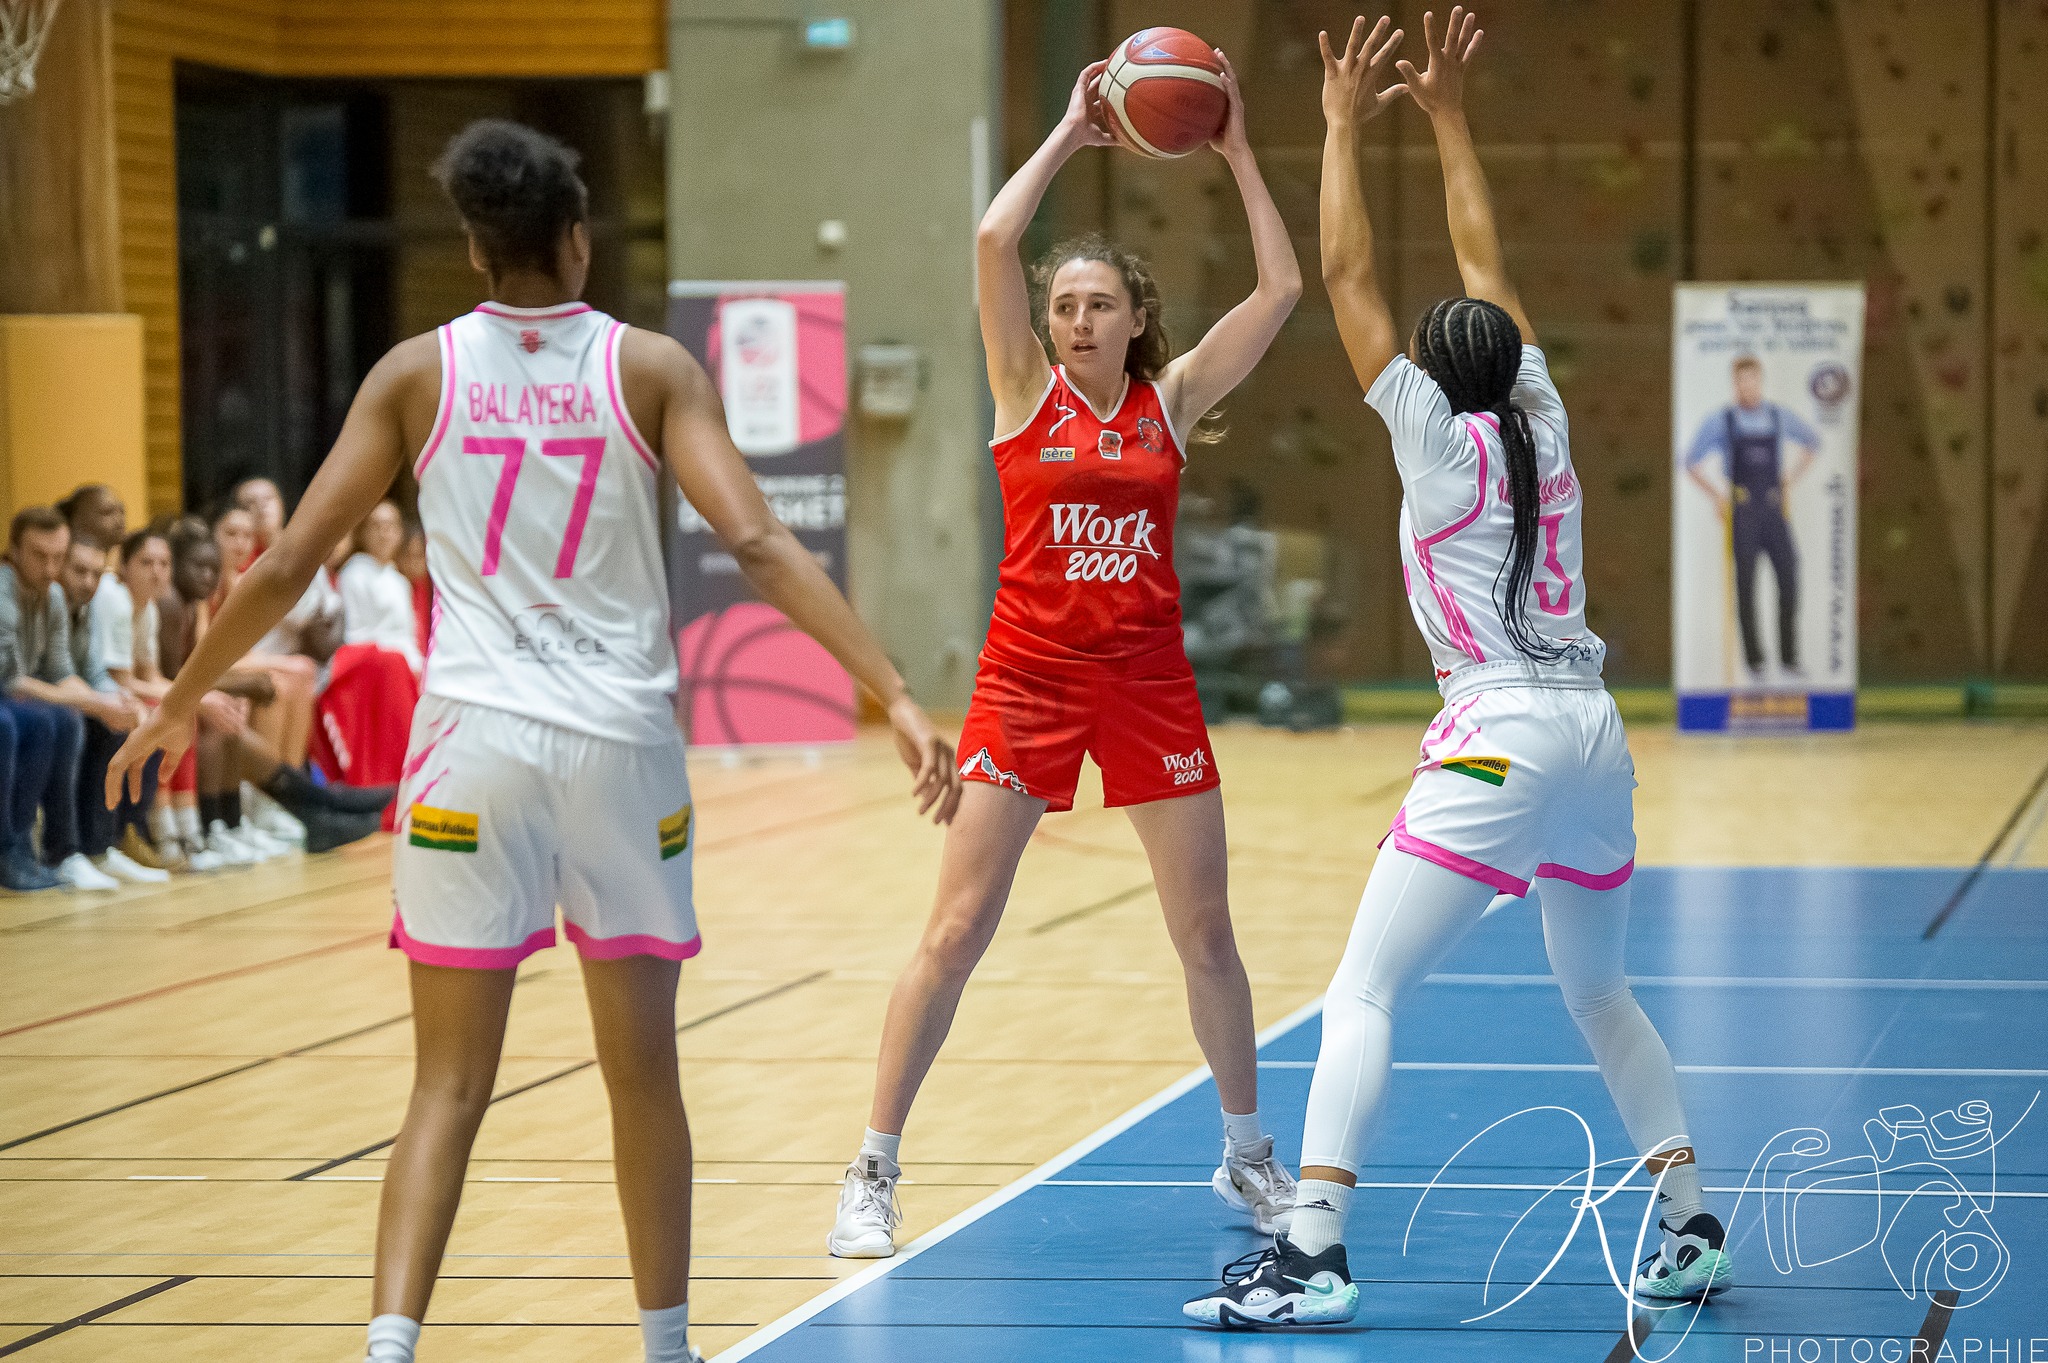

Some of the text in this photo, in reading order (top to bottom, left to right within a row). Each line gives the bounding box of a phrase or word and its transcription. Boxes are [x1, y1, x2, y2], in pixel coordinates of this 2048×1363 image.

[468, 382, 598, 426] BALAYERA
[1041, 447, 1073, 459] isère
[462, 436, 607, 579] 77
[1049, 503, 1158, 555] Work
[1065, 550, 1138, 583] 2000
[1533, 512, 1574, 616] 3
[1162, 747, 1208, 772] Work
[1174, 768, 1203, 786] 2000
